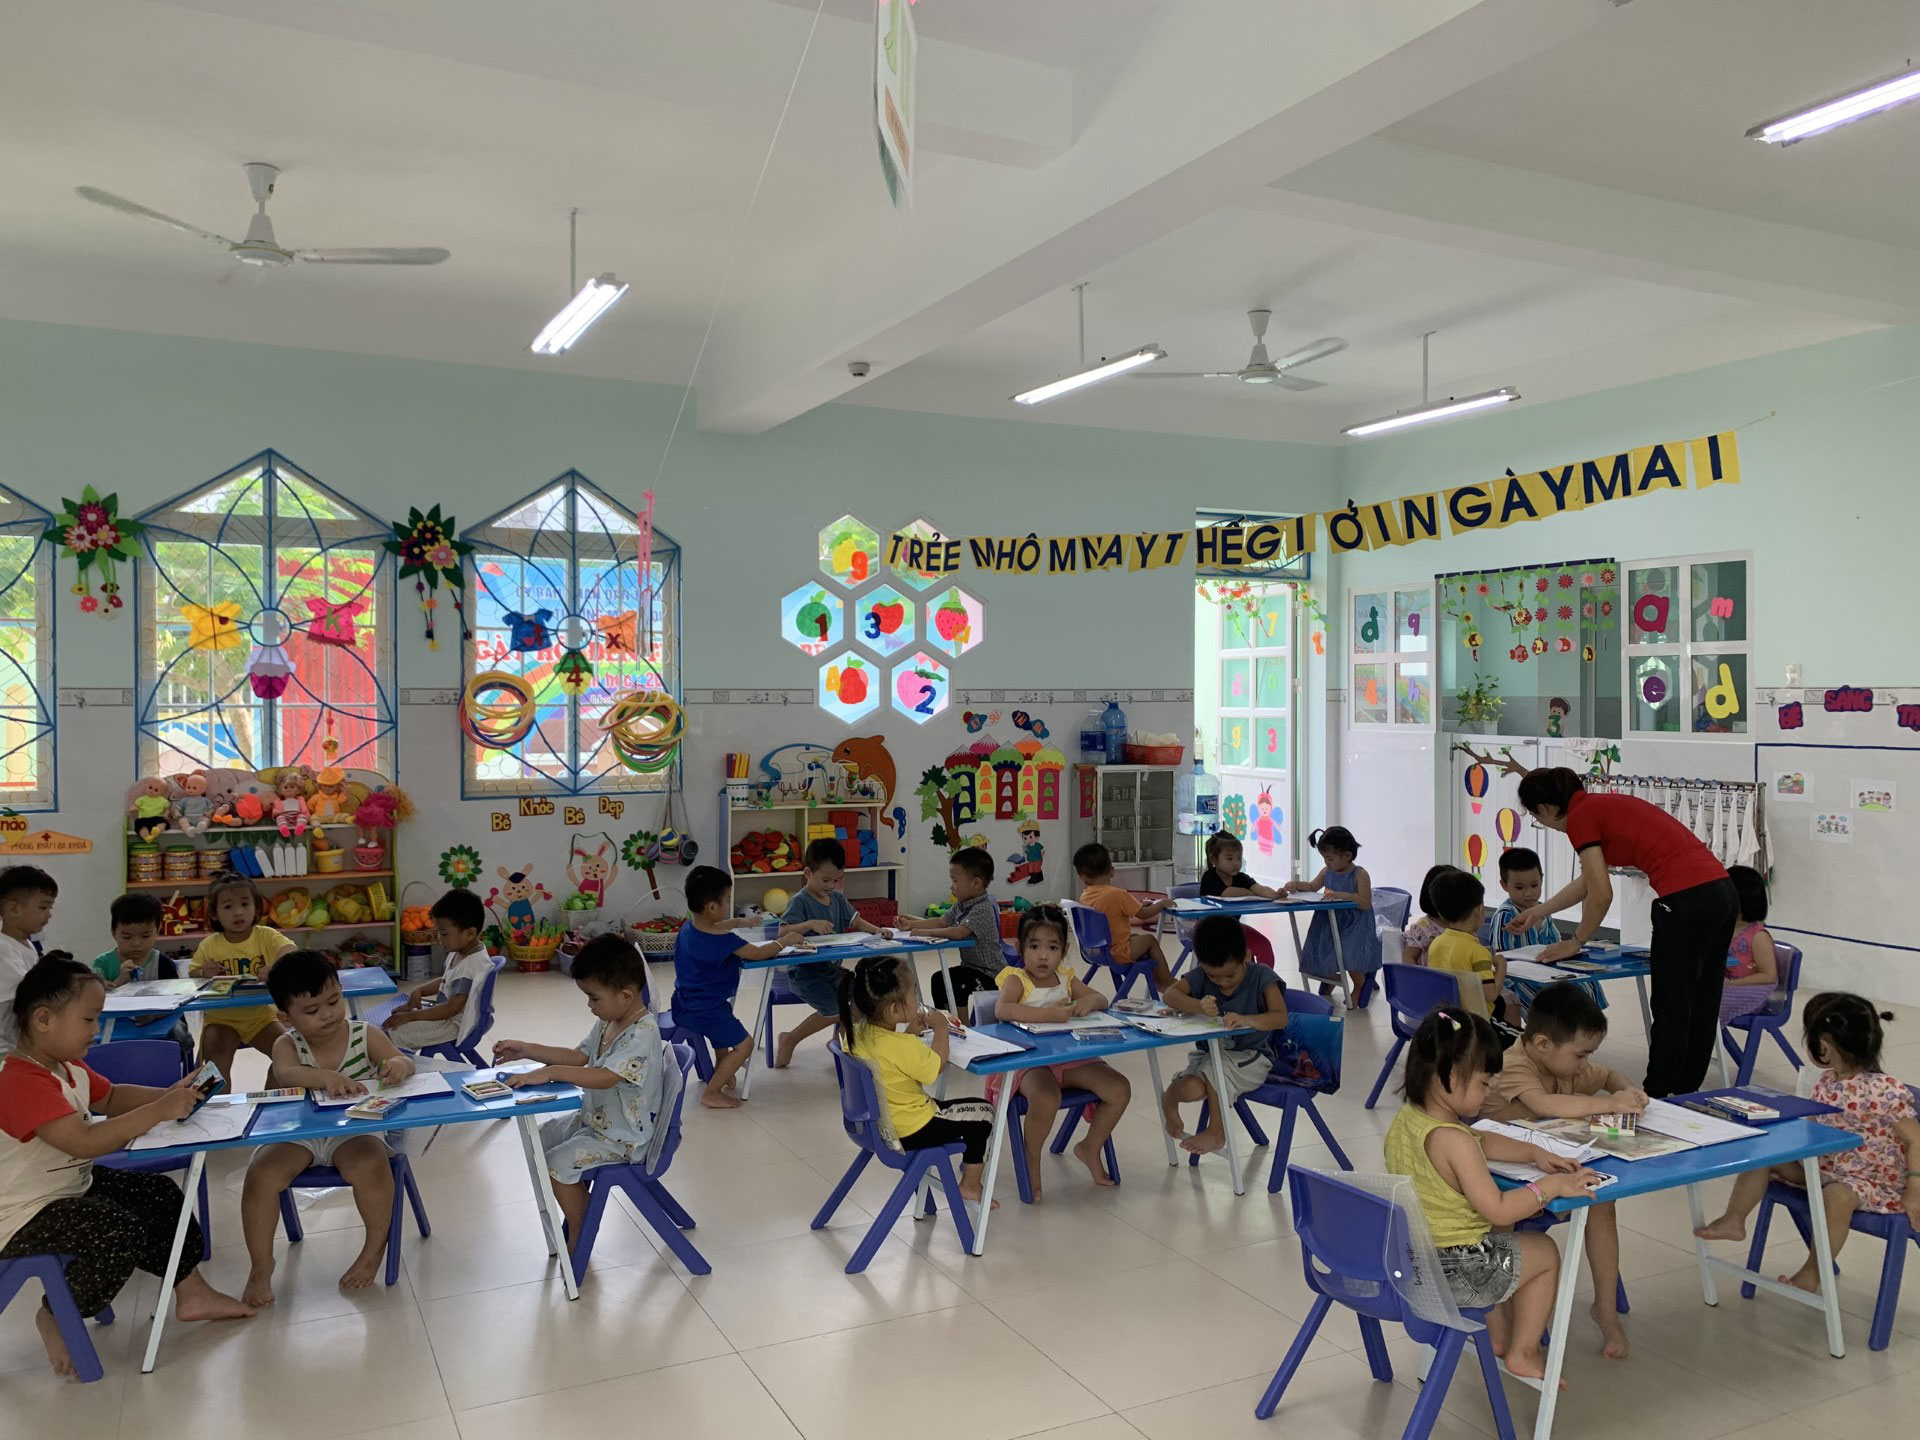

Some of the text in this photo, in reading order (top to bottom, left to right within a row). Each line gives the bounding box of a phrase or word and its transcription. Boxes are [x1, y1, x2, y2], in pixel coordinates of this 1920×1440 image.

[1582, 435, 1723, 504] MAI
[1710, 597, 1734, 619] m
[815, 613, 829, 641] 1
[864, 612, 882, 639] 3
[915, 685, 937, 714] 2
[1705, 663, 1739, 718] d
[1267, 727, 1277, 753] 3
